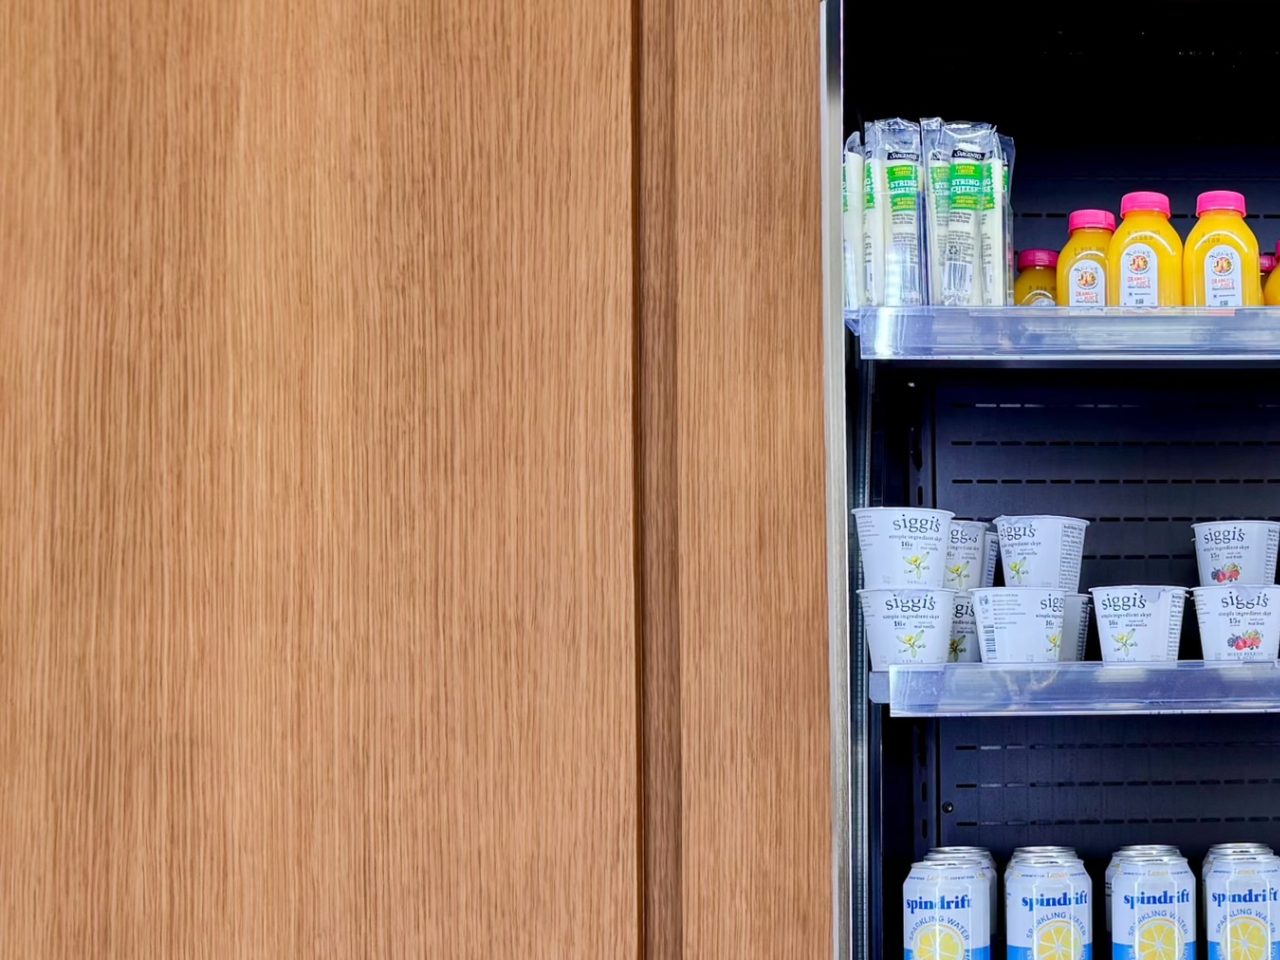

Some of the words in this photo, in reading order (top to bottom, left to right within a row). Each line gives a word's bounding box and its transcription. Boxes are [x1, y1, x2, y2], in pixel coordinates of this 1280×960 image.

[952, 179, 980, 187] STRING
[892, 514, 942, 533] siggi's
[1204, 526, 1245, 544] siggi's
[885, 593, 936, 613] siggi's
[1101, 593, 1147, 611] siggi's
[1221, 591, 1269, 610] siggi's
[1123, 889, 1190, 910] spindrift
[1211, 888, 1278, 907] spndrift
[947, 917, 970, 941] WATER
[1255, 910, 1276, 933] WAER
